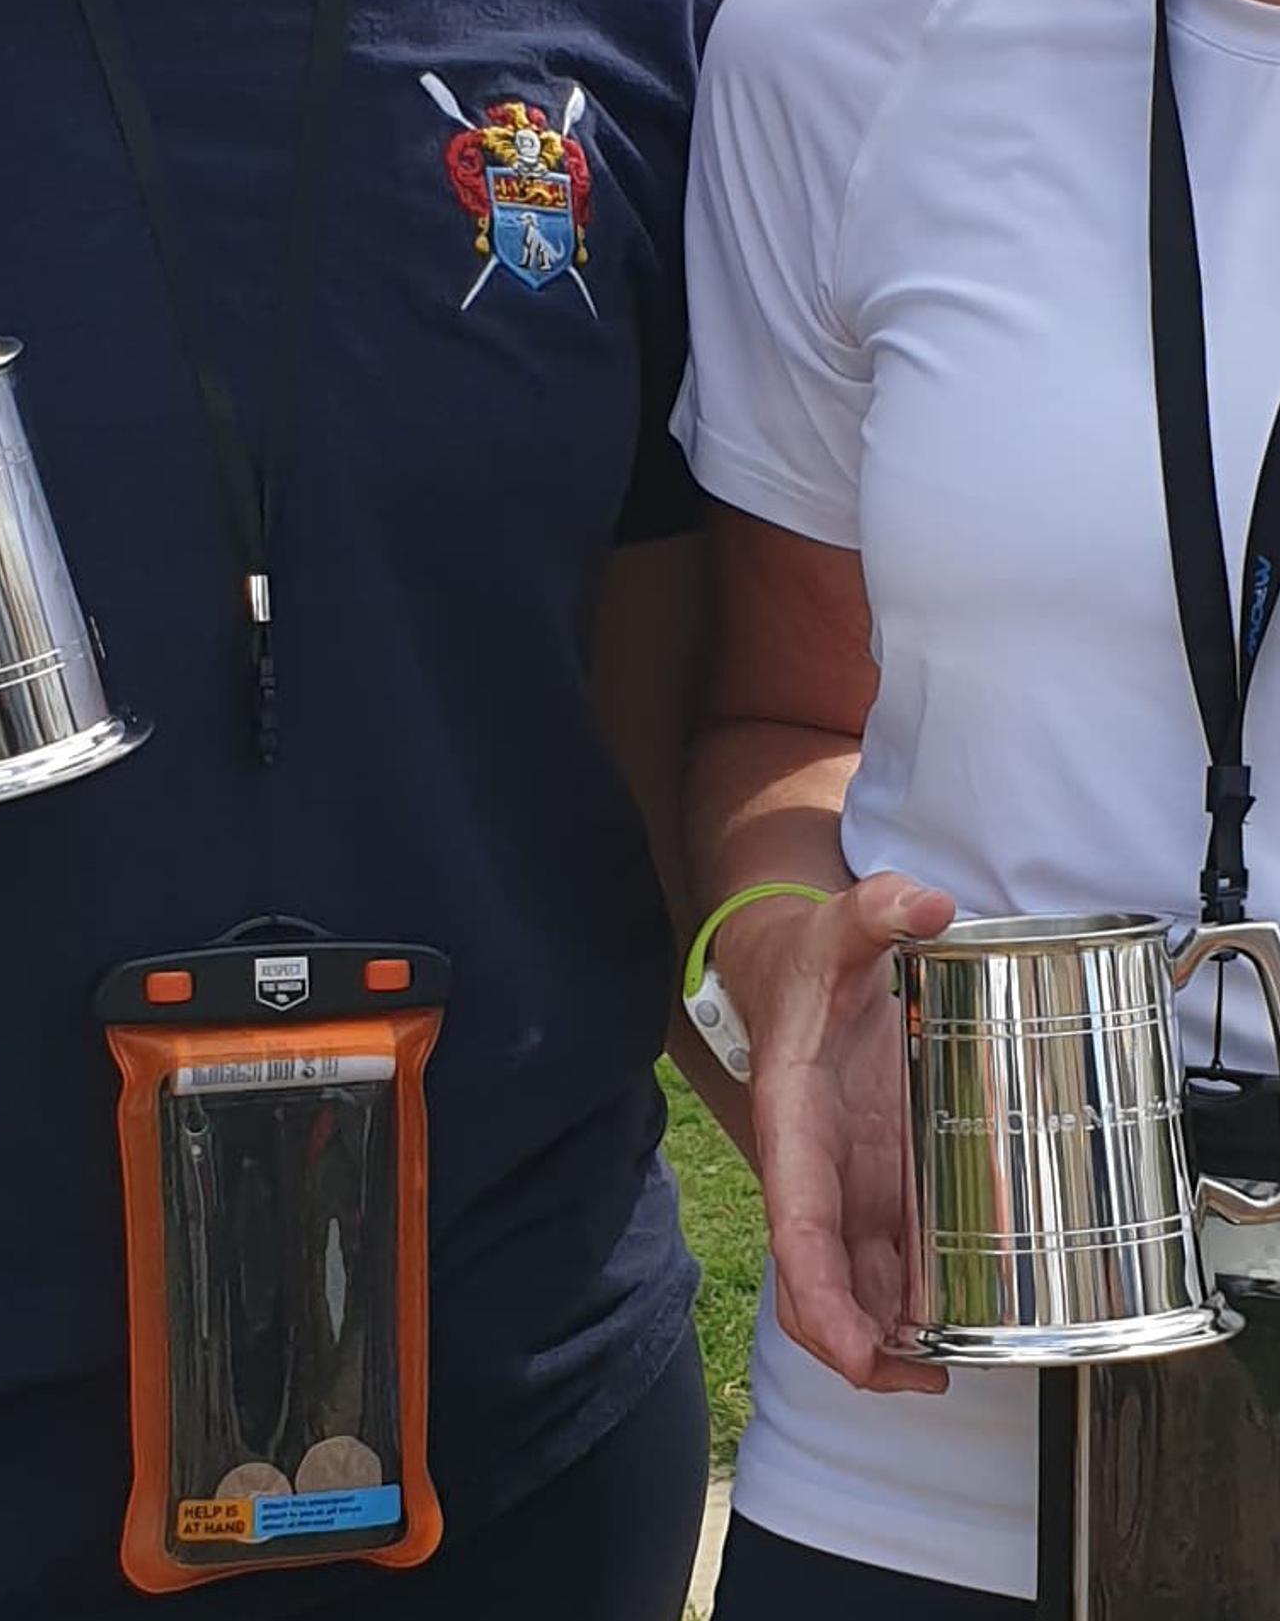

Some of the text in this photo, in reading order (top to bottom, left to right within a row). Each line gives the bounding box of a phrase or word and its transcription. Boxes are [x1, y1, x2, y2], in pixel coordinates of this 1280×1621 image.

[184, 1504, 238, 1519] HELP IS
[183, 1520, 245, 1534] AT HAND
